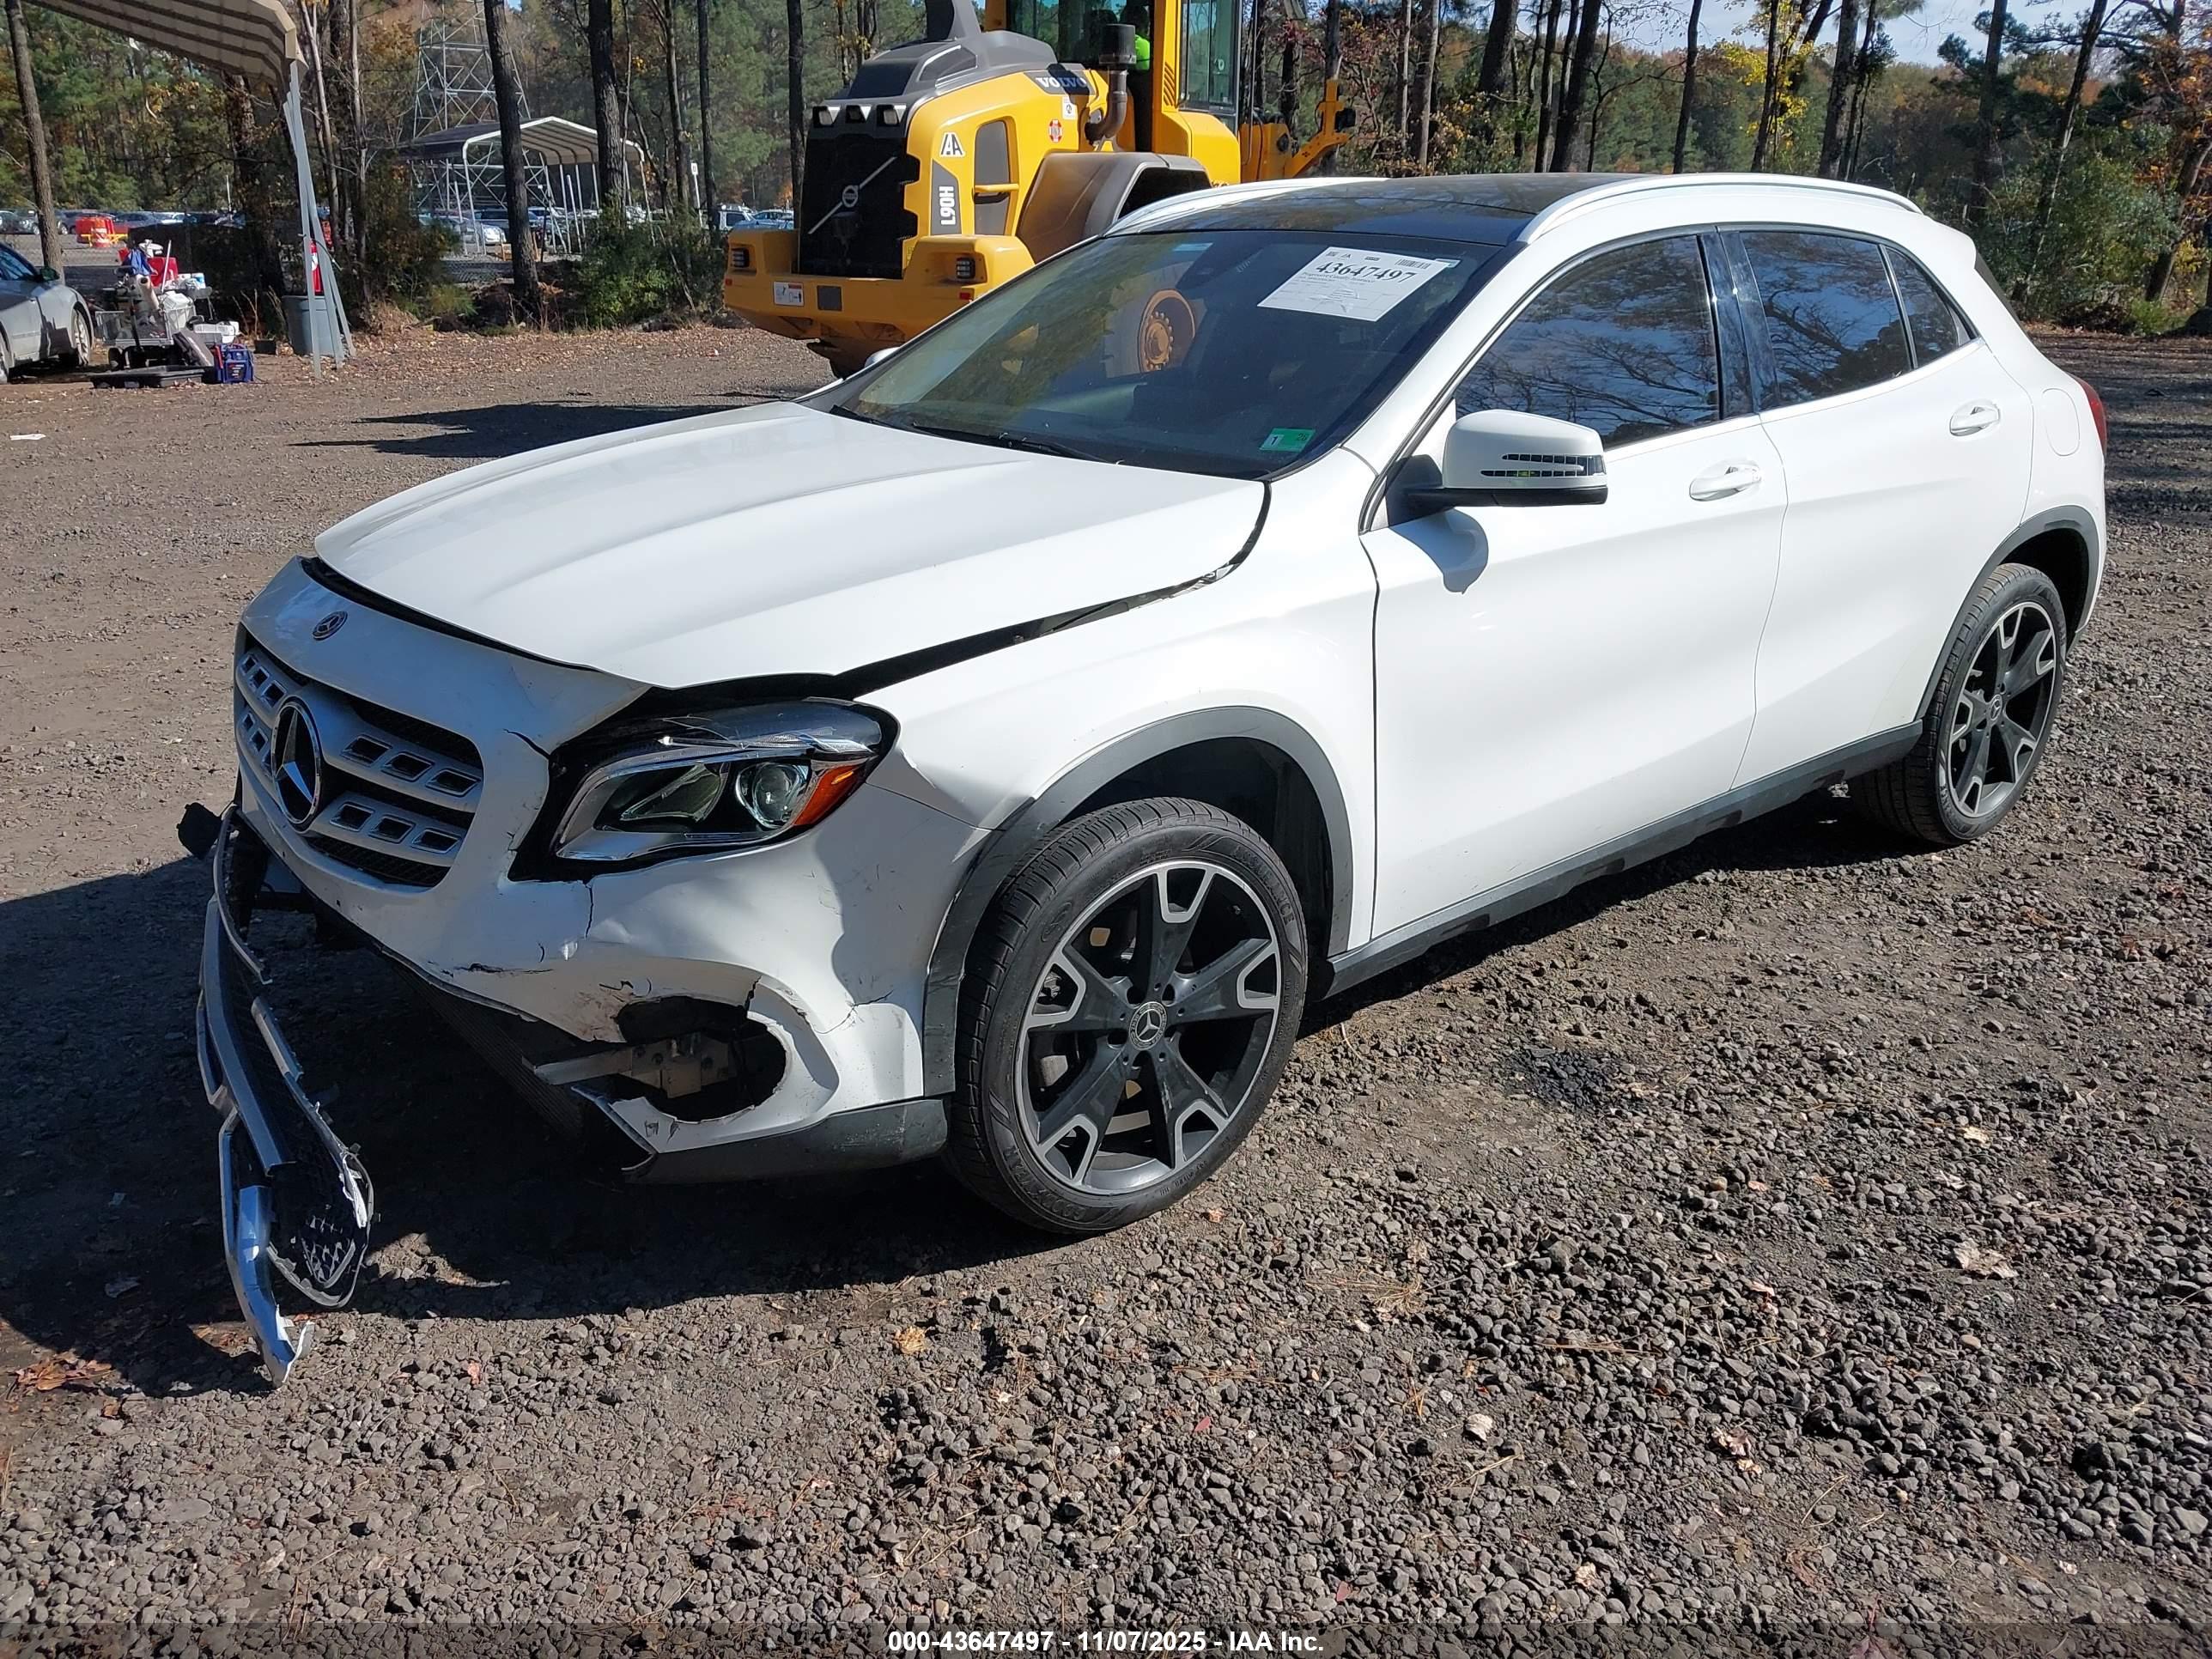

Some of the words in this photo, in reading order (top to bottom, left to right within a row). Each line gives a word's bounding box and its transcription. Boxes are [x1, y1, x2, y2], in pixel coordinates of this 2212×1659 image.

[1036, 76, 1087, 88] VOLVO
[939, 185, 957, 225] L90H
[1316, 261, 1417, 283] 43647497
